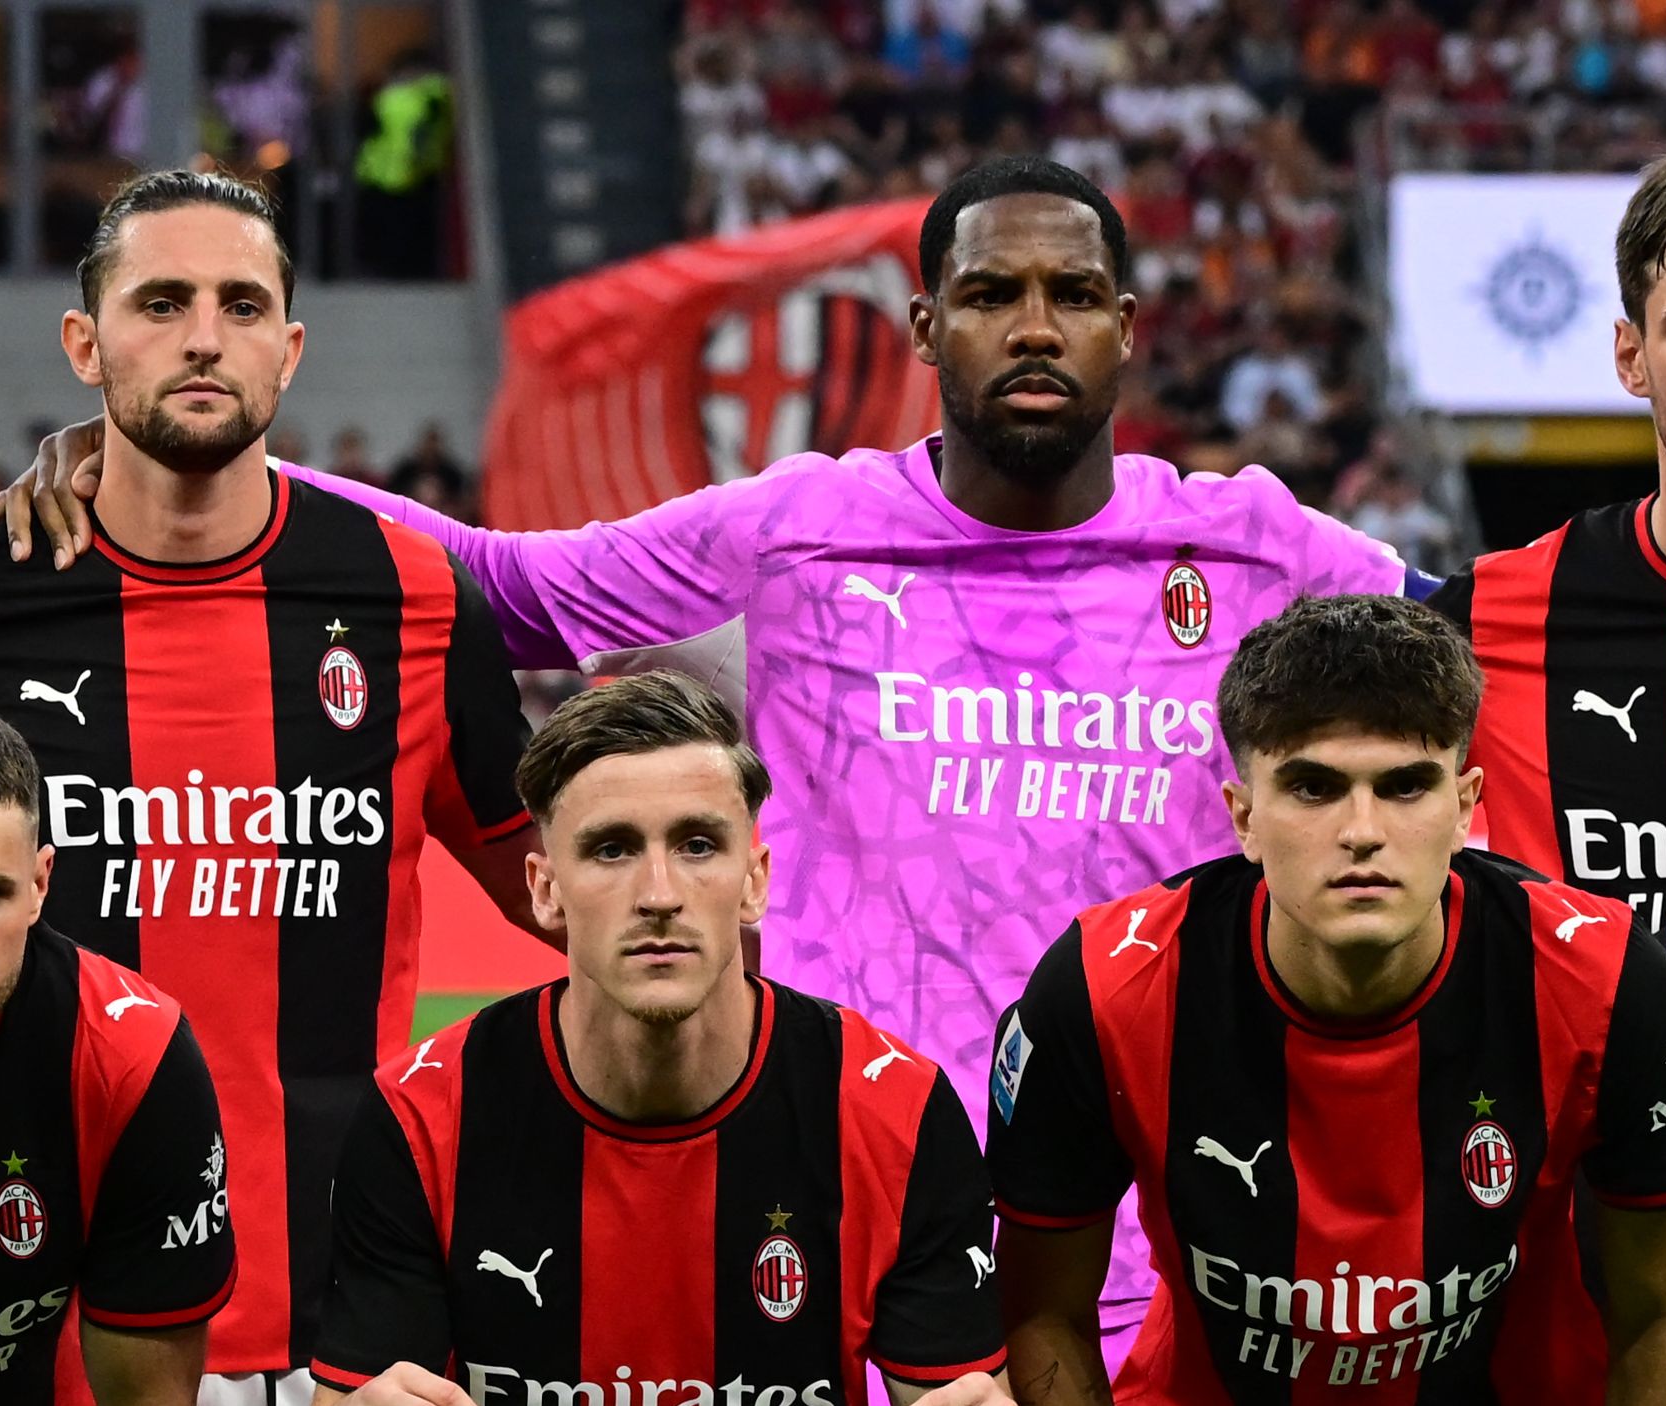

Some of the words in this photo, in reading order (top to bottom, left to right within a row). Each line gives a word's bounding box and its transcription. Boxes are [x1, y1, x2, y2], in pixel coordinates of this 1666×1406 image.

[1172, 569, 1198, 584] ACM
[1177, 627, 1200, 639] 1899
[329, 652, 356, 668] ACM
[332, 708, 356, 722] 1899
[874, 672, 1214, 757] Emirates
[927, 757, 1004, 816] FLY
[1016, 760, 1171, 825] BETTER
[44, 769, 384, 848] Emirates
[100, 858, 175, 918] FLY
[189, 858, 340, 918] BETTER
[1472, 1127, 1503, 1143] ACM
[2, 1186, 32, 1199] ACM
[1478, 1187, 1506, 1199] 1899
[763, 1241, 795, 1258] ACM
[767, 1301, 794, 1314] 1899
[1238, 1327, 1315, 1380] FLY
[1328, 1306, 1483, 1386] BETTER
